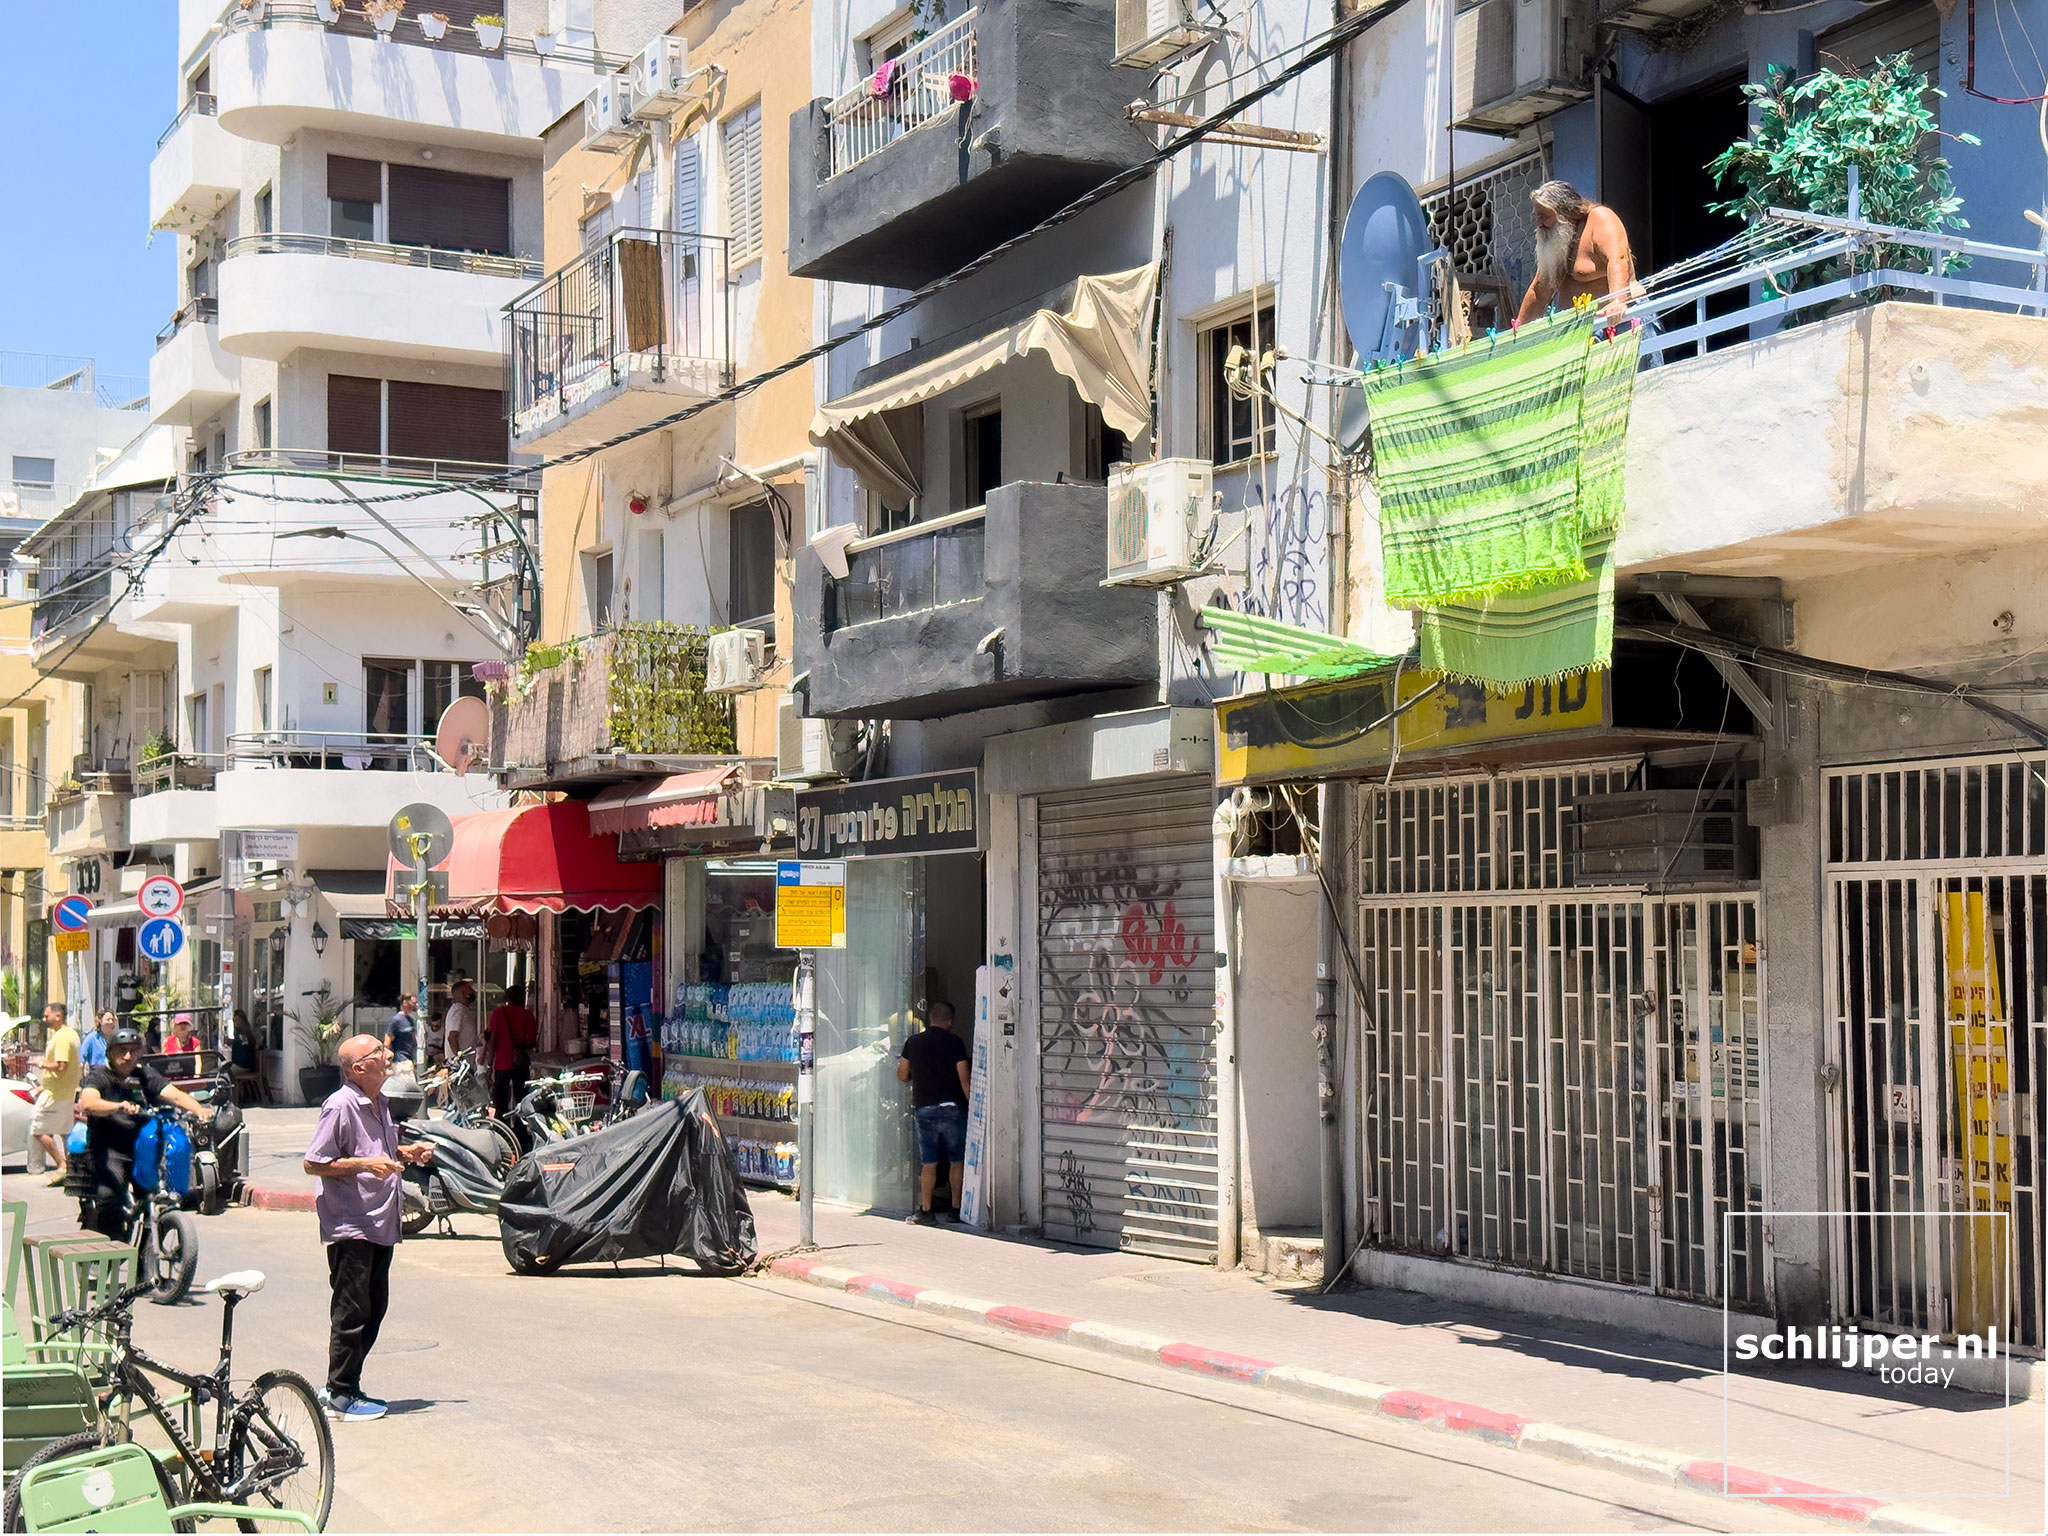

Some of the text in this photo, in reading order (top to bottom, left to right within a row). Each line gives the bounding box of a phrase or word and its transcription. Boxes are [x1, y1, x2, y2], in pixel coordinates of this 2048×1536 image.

[799, 806, 821, 853] 37
[823, 802, 899, 854] פלורנטין
[901, 782, 973, 836] הגלריה
